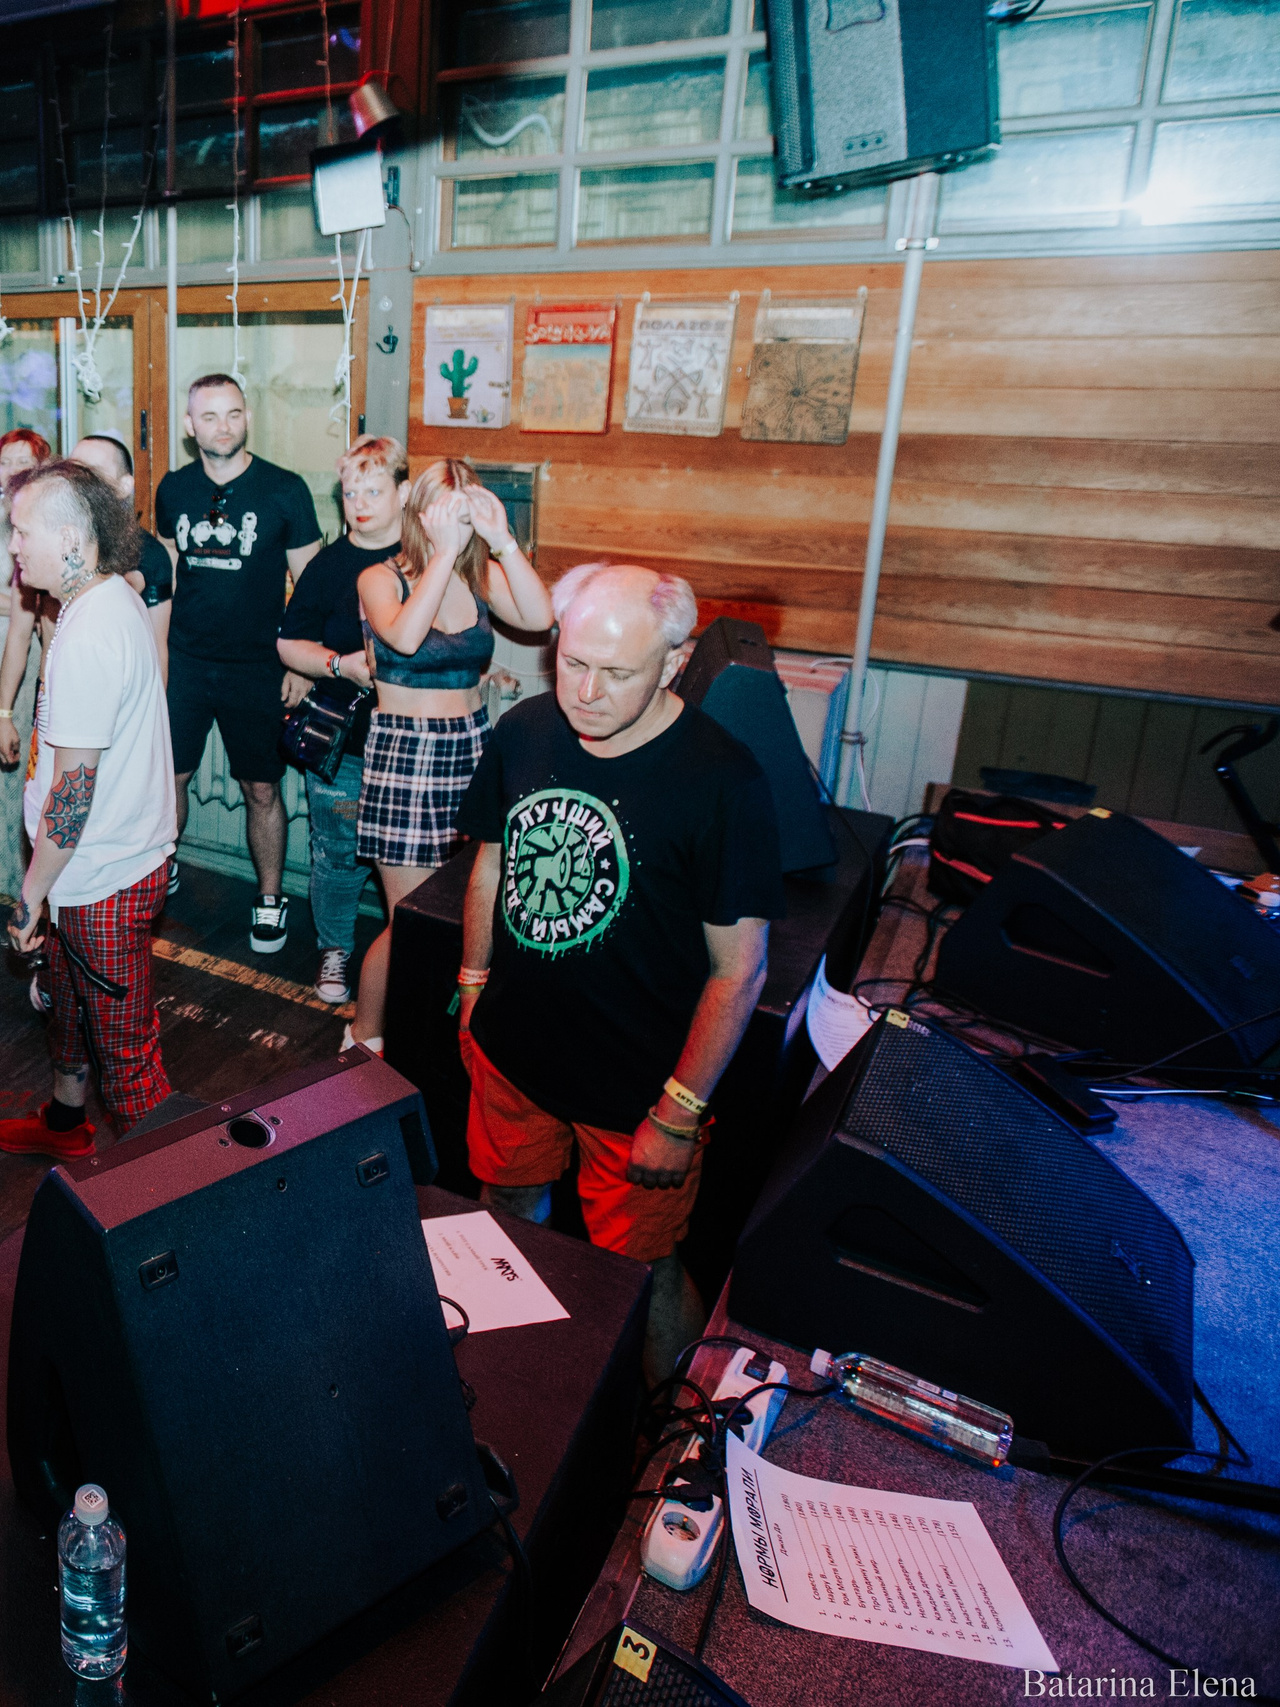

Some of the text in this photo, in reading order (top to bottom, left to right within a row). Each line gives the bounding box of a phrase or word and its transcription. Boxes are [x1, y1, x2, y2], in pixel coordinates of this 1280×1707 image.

[518, 800, 615, 857] ЛУЧШИЙ
[531, 877, 615, 942] САМЫЙ
[741, 1467, 778, 1589] НОРМЫ МОРАЛИ
[870, 1560, 879, 1575] мир
[917, 1571, 929, 1589] день
[807, 1572, 820, 1600] Совесть
[851, 1579, 866, 1608] Бунтарь
[860, 1568, 874, 1595] Родину
[875, 1575, 896, 1613] Безумный
[936, 1583, 947, 1599] Nice
[841, 1592, 851, 1606] Рок
[871, 1596, 881, 1610] Про
[912, 1592, 927, 1619] Нельзя
[923, 1589, 943, 1621] Каждый
[943, 1601, 958, 1624] Fuckin
[977, 1582, 1005, 1632] Контрабанда
[974, 1607, 989, 1630] Весна
[621, 1635, 650, 1661] 3
